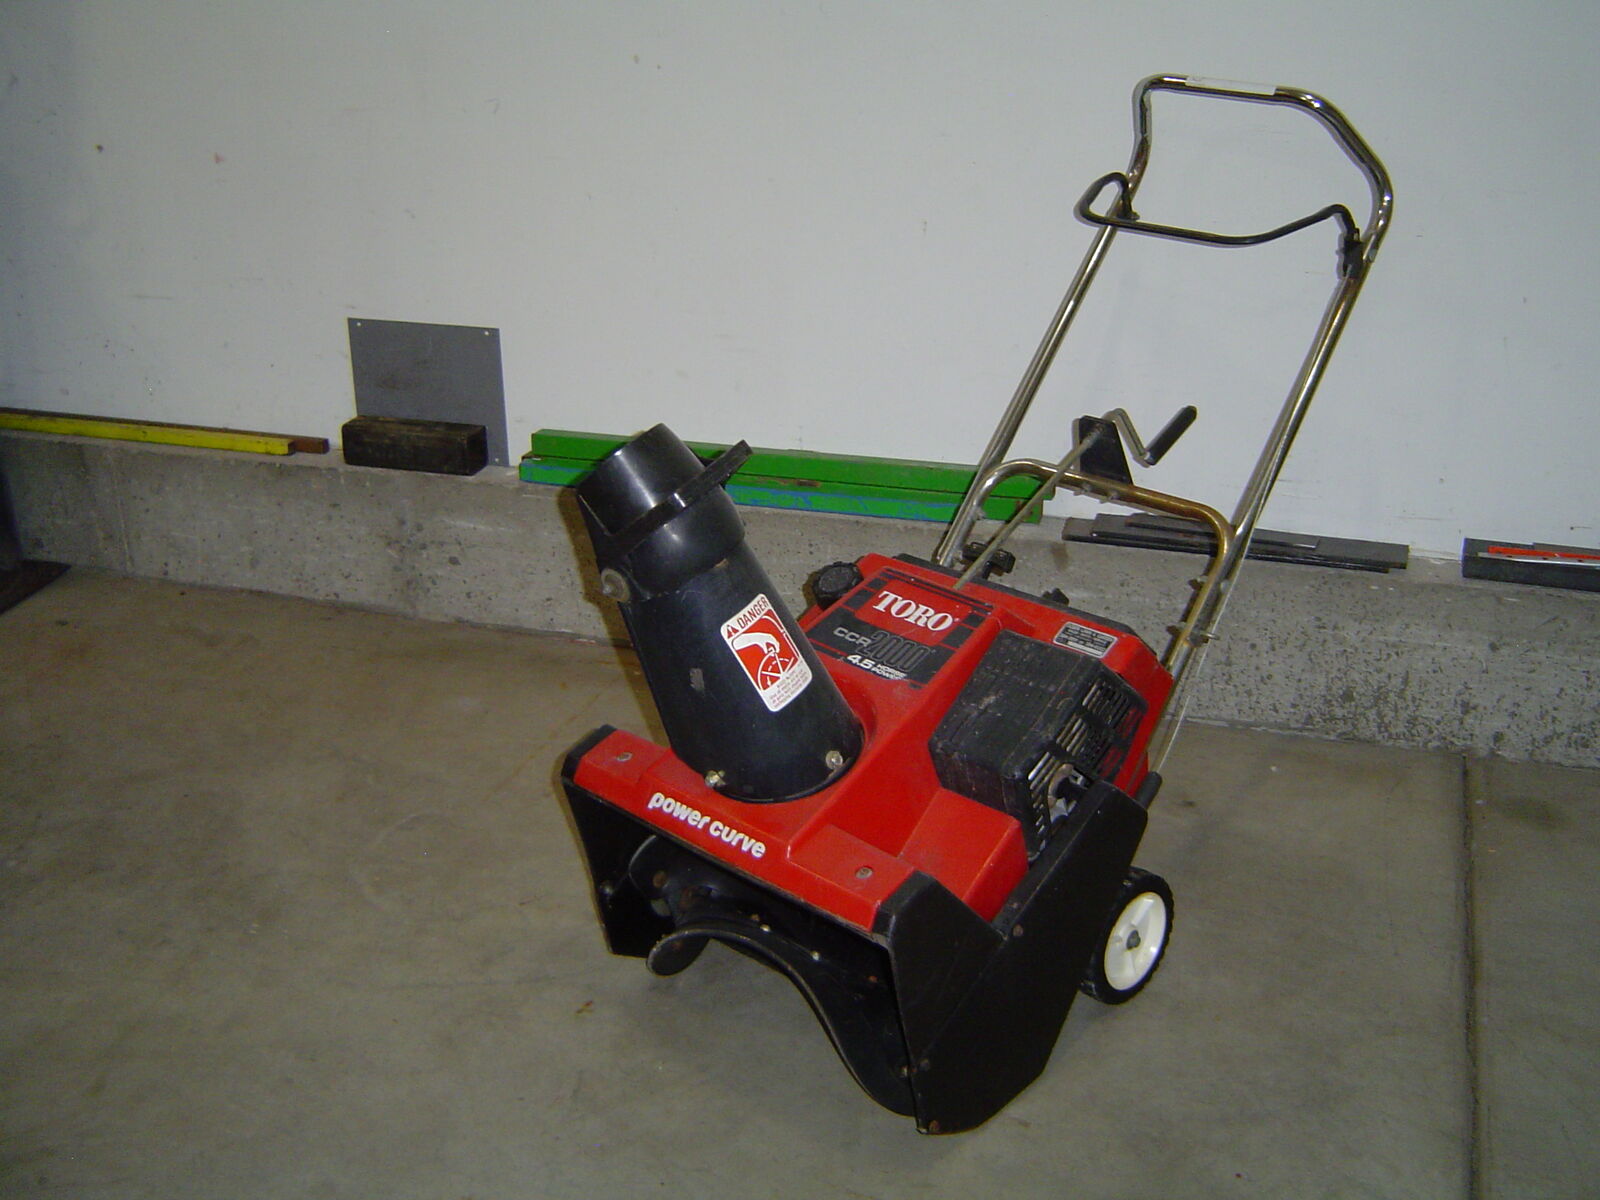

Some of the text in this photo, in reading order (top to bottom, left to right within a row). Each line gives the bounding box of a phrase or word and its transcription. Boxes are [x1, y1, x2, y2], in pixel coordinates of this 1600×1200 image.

[737, 596, 769, 629] DANGER
[872, 590, 954, 632] TORO
[833, 626, 930, 672] CCR 2000
[846, 654, 876, 670] 4.5
[647, 792, 766, 858] power curve
